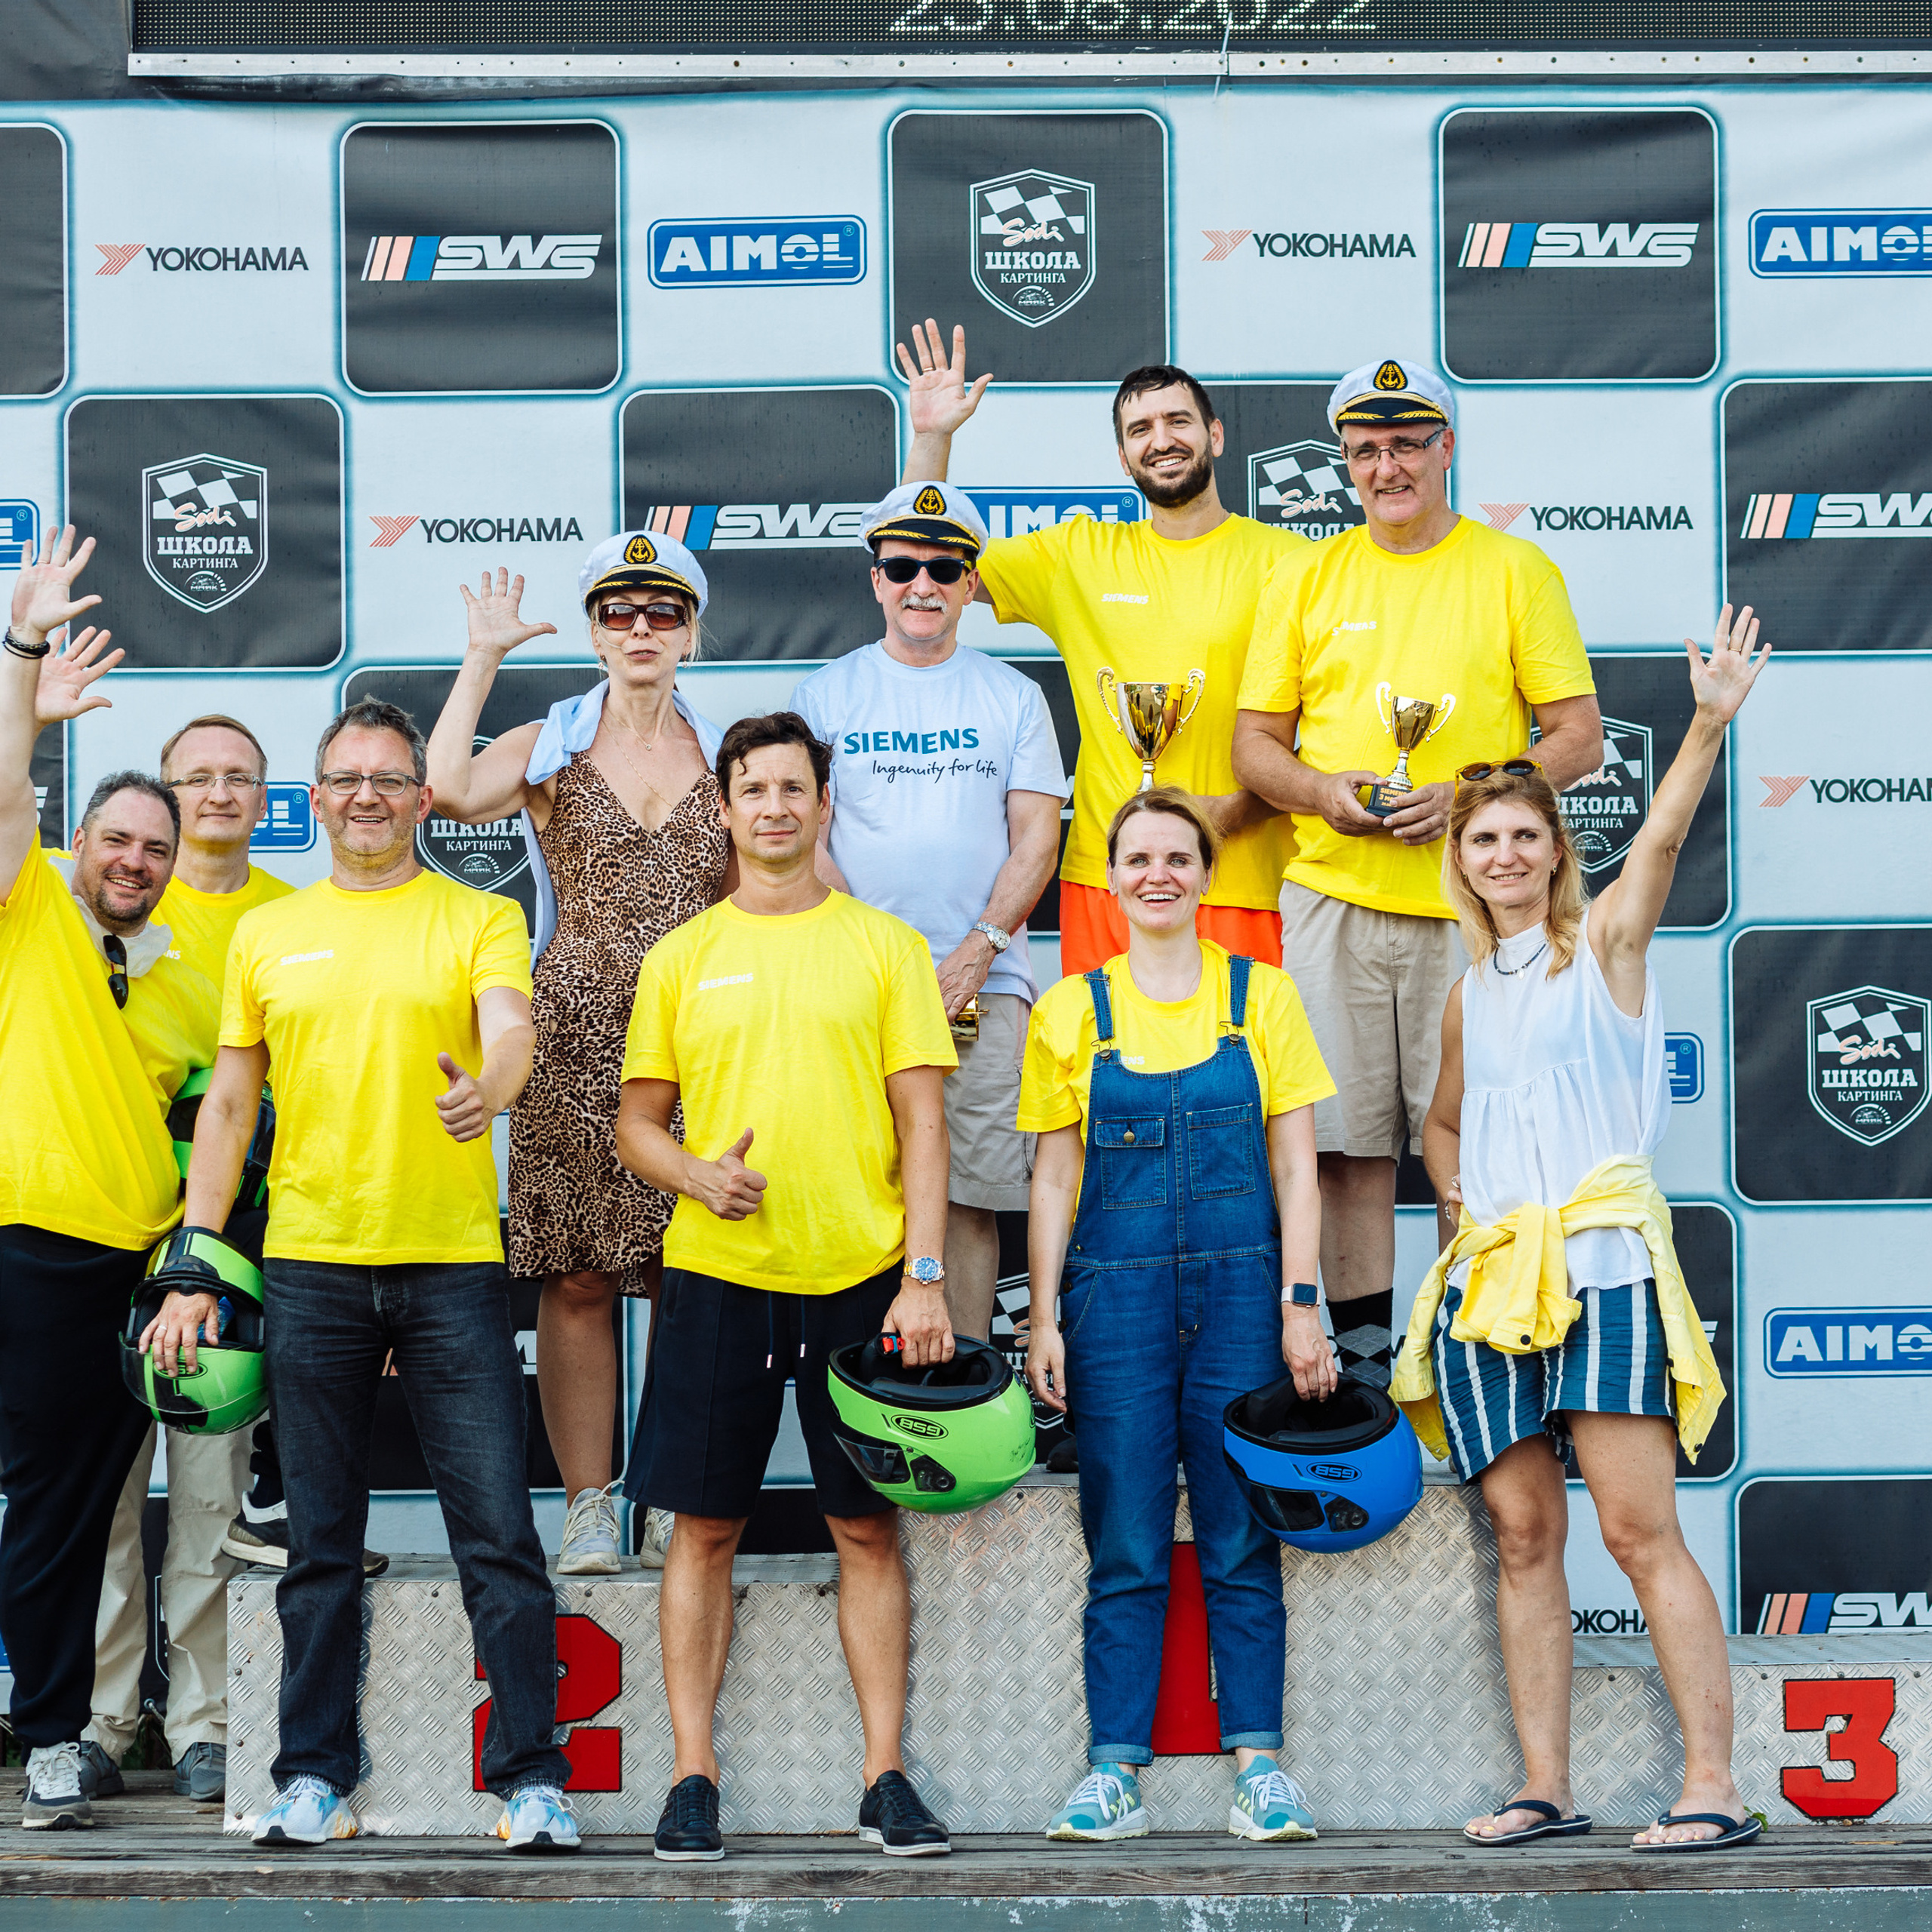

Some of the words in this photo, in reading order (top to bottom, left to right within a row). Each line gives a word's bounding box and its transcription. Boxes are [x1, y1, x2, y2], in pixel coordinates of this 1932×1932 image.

[1001, 217, 1066, 248] Sodi
[1252, 232, 1417, 258] YOKOHAMA
[1528, 223, 1700, 268] SWS
[146, 246, 309, 272] YOKOHAMA
[431, 234, 603, 281] SWS
[659, 233, 854, 272] AIMOL
[984, 251, 1082, 269] ШКОЛА
[1000, 272, 1067, 284] КАРТИНГА
[1279, 488, 1343, 518] Sodi
[1810, 492, 1932, 539] SW
[174, 502, 238, 533] Sodi
[420, 517, 585, 544] YOKOHAMA
[1529, 506, 1694, 531] YOKOHAMA
[157, 537, 254, 555] ШКОЛА
[172, 558, 238, 569] КАРТИНГА
[1101, 592, 1149, 605] SIEMENS
[843, 728, 980, 755] SIEMENS
[872, 759, 946, 784] Ingenuity
[948, 758, 975, 777] for
[976, 759, 998, 779] life
[1563, 765, 1623, 792] odi
[1809, 778, 1932, 804] YOKOHA
[446, 839, 512, 851] КАРТИНГА
[280, 949, 334, 967] SIEMENS
[698, 972, 754, 992] SIEMENS
[1838, 1034, 1902, 1066] Sodi
[1821, 1068, 1919, 1088] ШКОЛА
[1837, 1090, 1903, 1102] КАРТИНГА
[1775, 1323, 1932, 1362] AIMO
[1828, 1592, 1932, 1634] SW
[1782, 1677, 1898, 1819] 3
